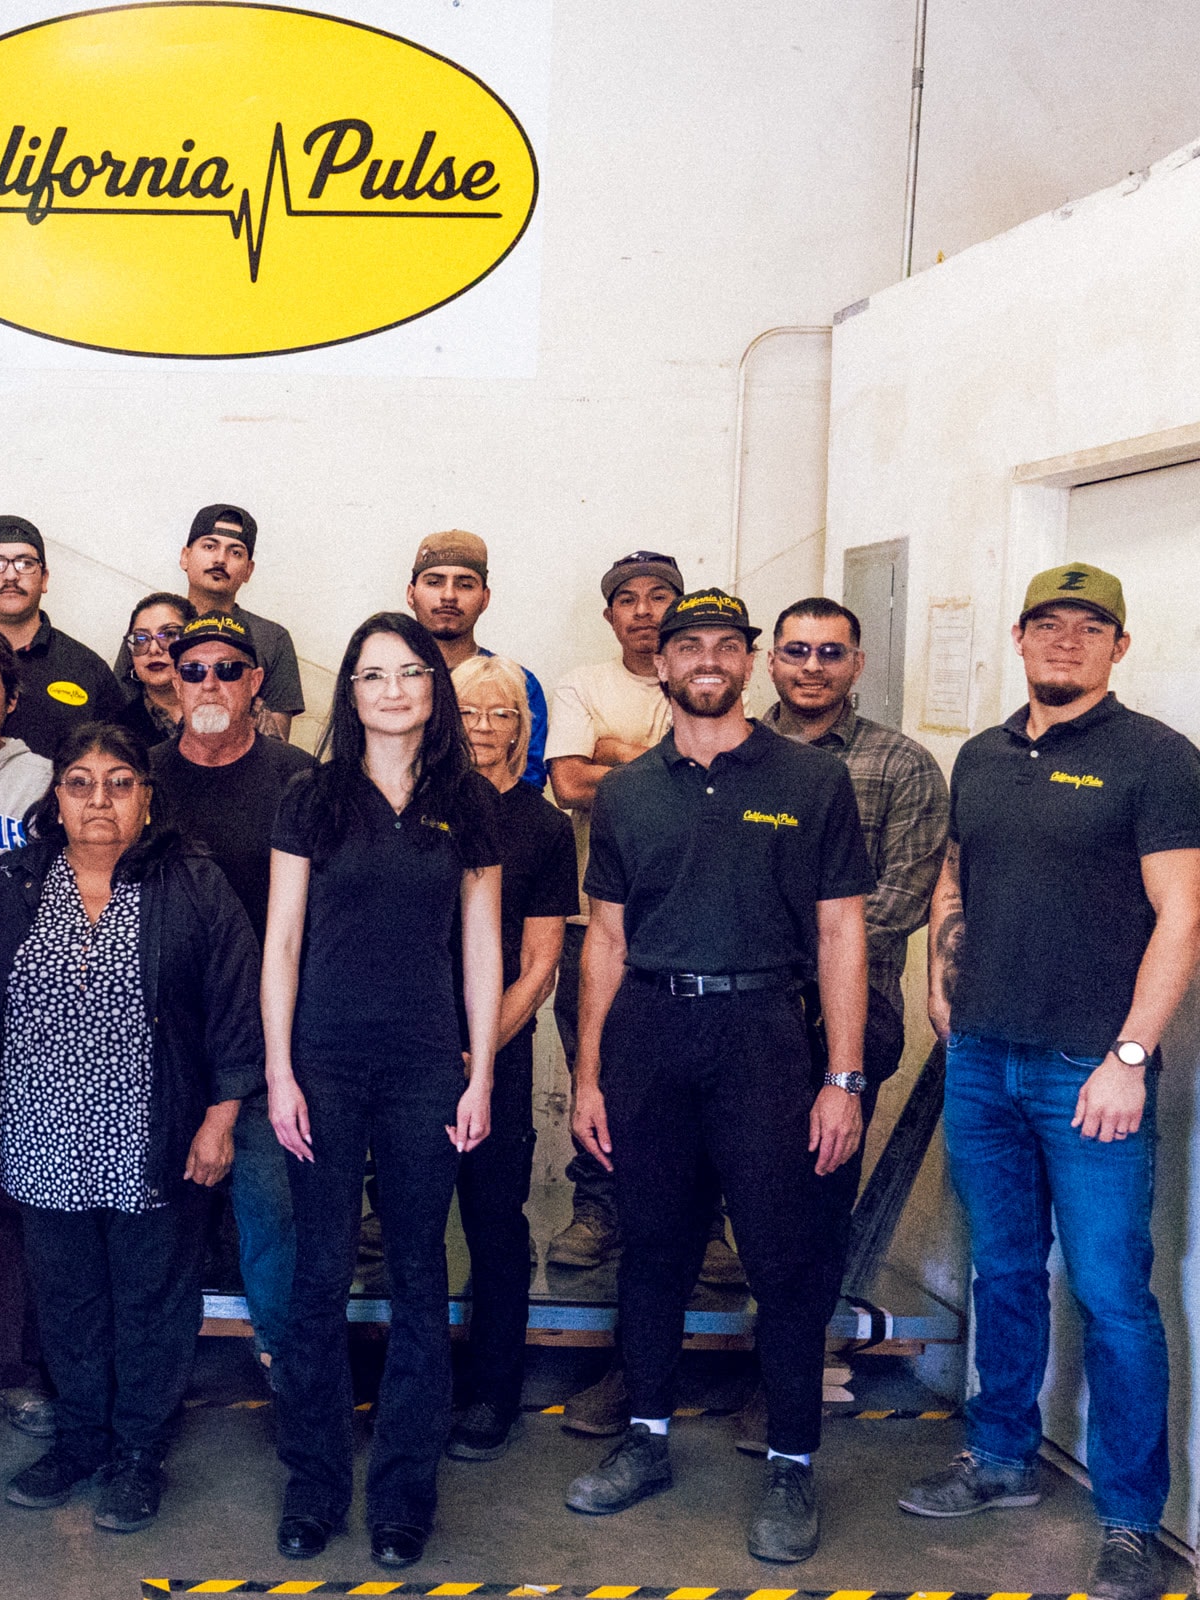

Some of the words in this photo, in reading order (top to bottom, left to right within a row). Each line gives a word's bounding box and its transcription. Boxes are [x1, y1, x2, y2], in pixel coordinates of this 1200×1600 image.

[303, 118, 502, 201] Pulse
[676, 594, 718, 613] California
[184, 617, 219, 634] California
[224, 617, 245, 634] Pulse
[1050, 770, 1081, 783] California
[1085, 774, 1103, 787] Pulse
[743, 809, 775, 823] California
[780, 813, 798, 825] Pulse
